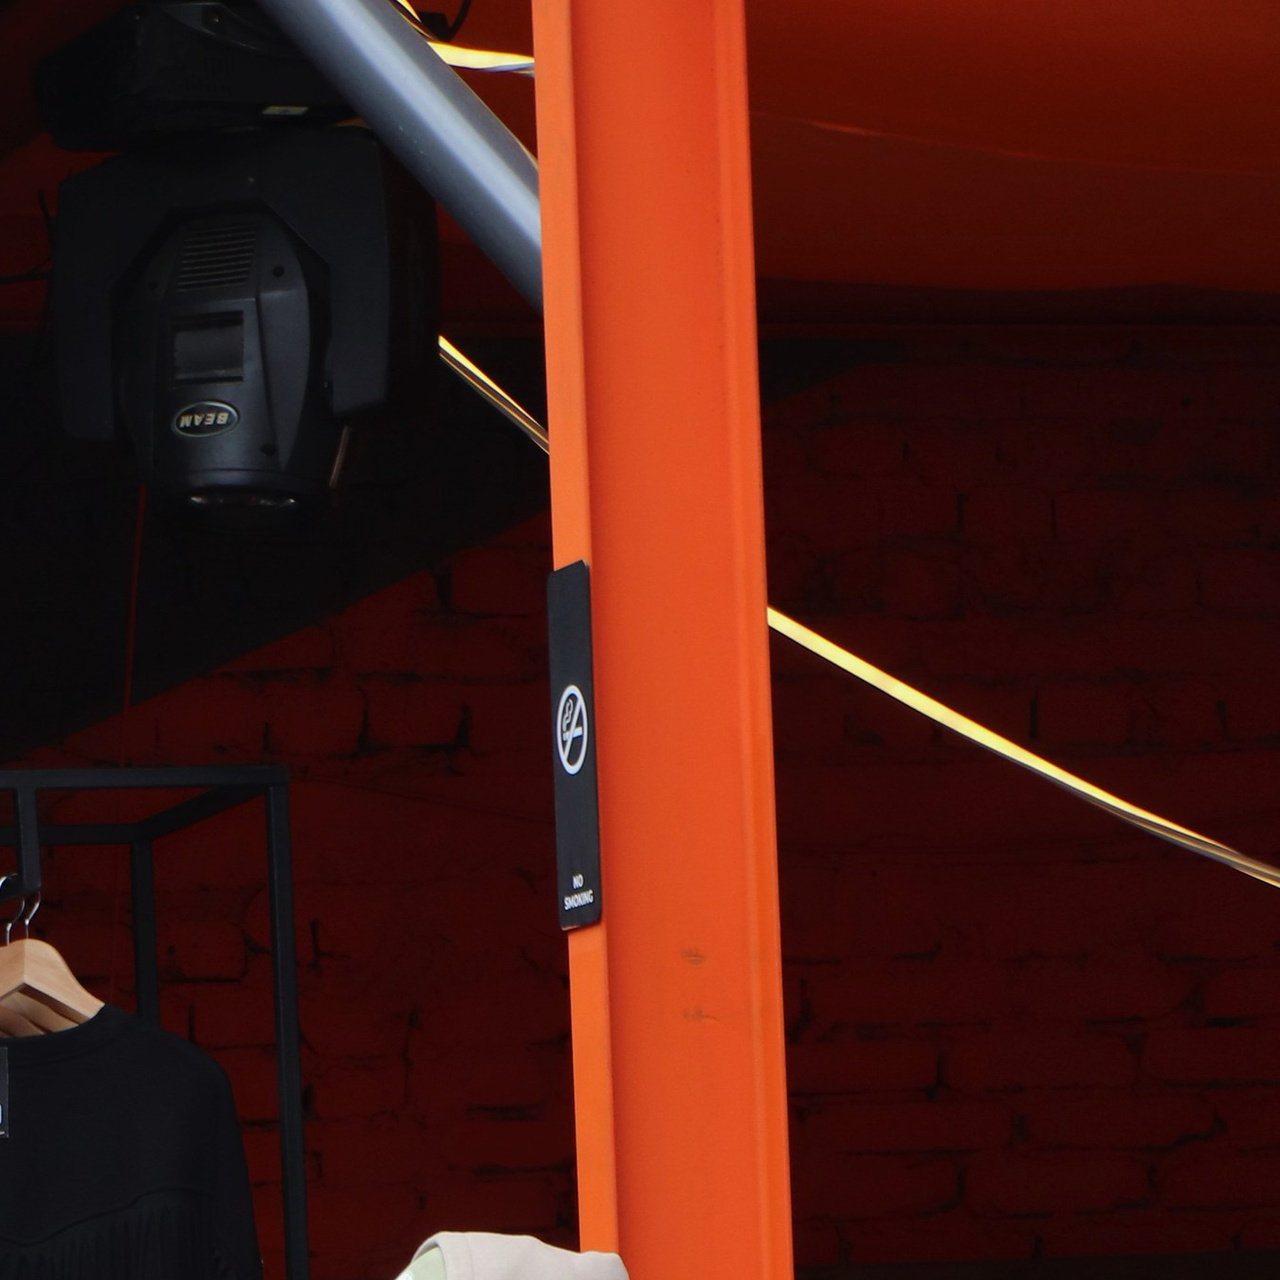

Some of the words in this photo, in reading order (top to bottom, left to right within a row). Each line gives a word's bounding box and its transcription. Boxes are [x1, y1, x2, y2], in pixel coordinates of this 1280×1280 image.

[180, 412, 229, 428] BEAM
[573, 874, 584, 889] NO
[564, 889, 593, 910] SMOKING
